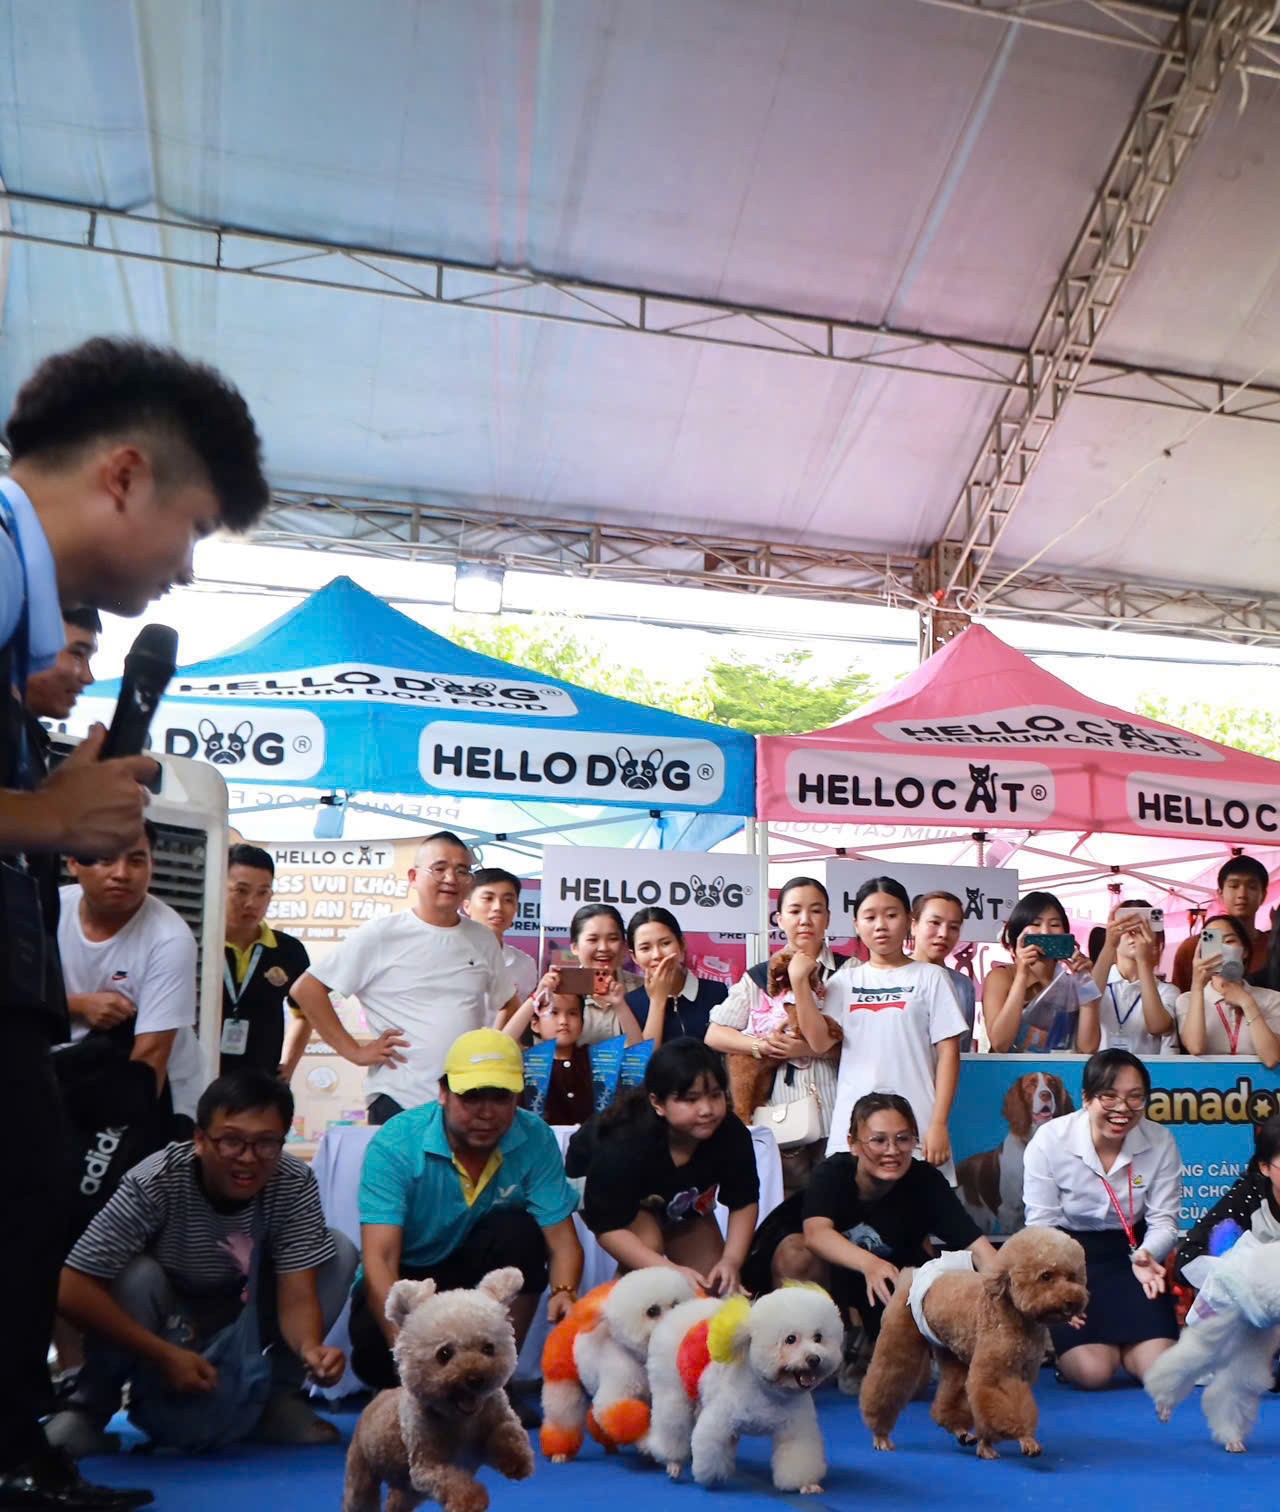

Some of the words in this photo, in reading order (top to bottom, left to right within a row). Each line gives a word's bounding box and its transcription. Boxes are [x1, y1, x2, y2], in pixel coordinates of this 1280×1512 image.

[179, 671, 381, 692] HELLO
[367, 688, 442, 703] DOG
[451, 698, 548, 712] FOOD
[900, 716, 1064, 737] HELLO
[1064, 734, 1115, 747] CAT
[1121, 741, 1202, 758] FOOD
[433, 744, 577, 784] HELLO
[798, 773, 925, 808] HELLO
[1138, 791, 1250, 829] HELLO
[275, 850, 336, 865] HELLO
[310, 875, 347, 893] VUI
[560, 877, 662, 905] HELLO
[313, 900, 345, 920] AN
[963, 887, 1004, 920] AT
[1208, 1161, 1240, 1176] CÂN
